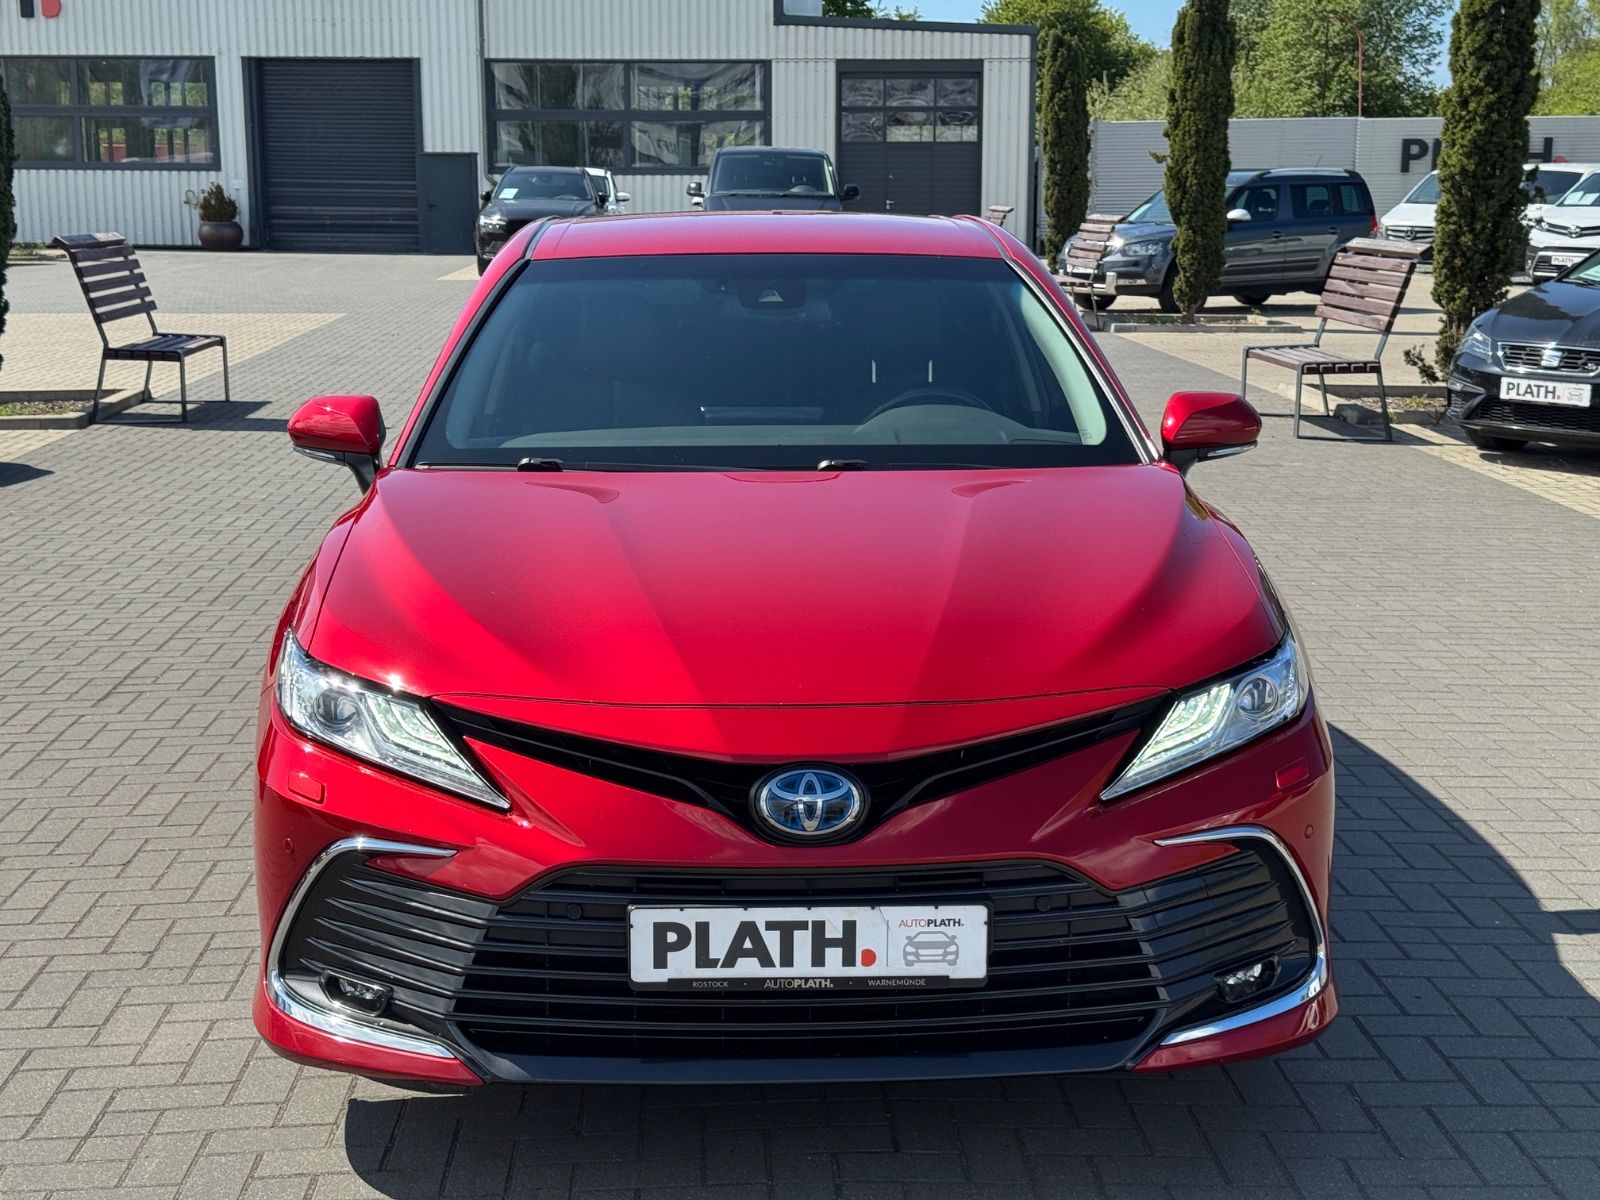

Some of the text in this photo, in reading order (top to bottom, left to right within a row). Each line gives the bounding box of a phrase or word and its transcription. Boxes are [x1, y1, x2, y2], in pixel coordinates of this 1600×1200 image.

[899, 918, 964, 927] AUTOPLATH.
[653, 920, 877, 969] PLATH.
[692, 978, 926, 989] ROSTOCK AUTOPLATH. WARNEMÜNDE
